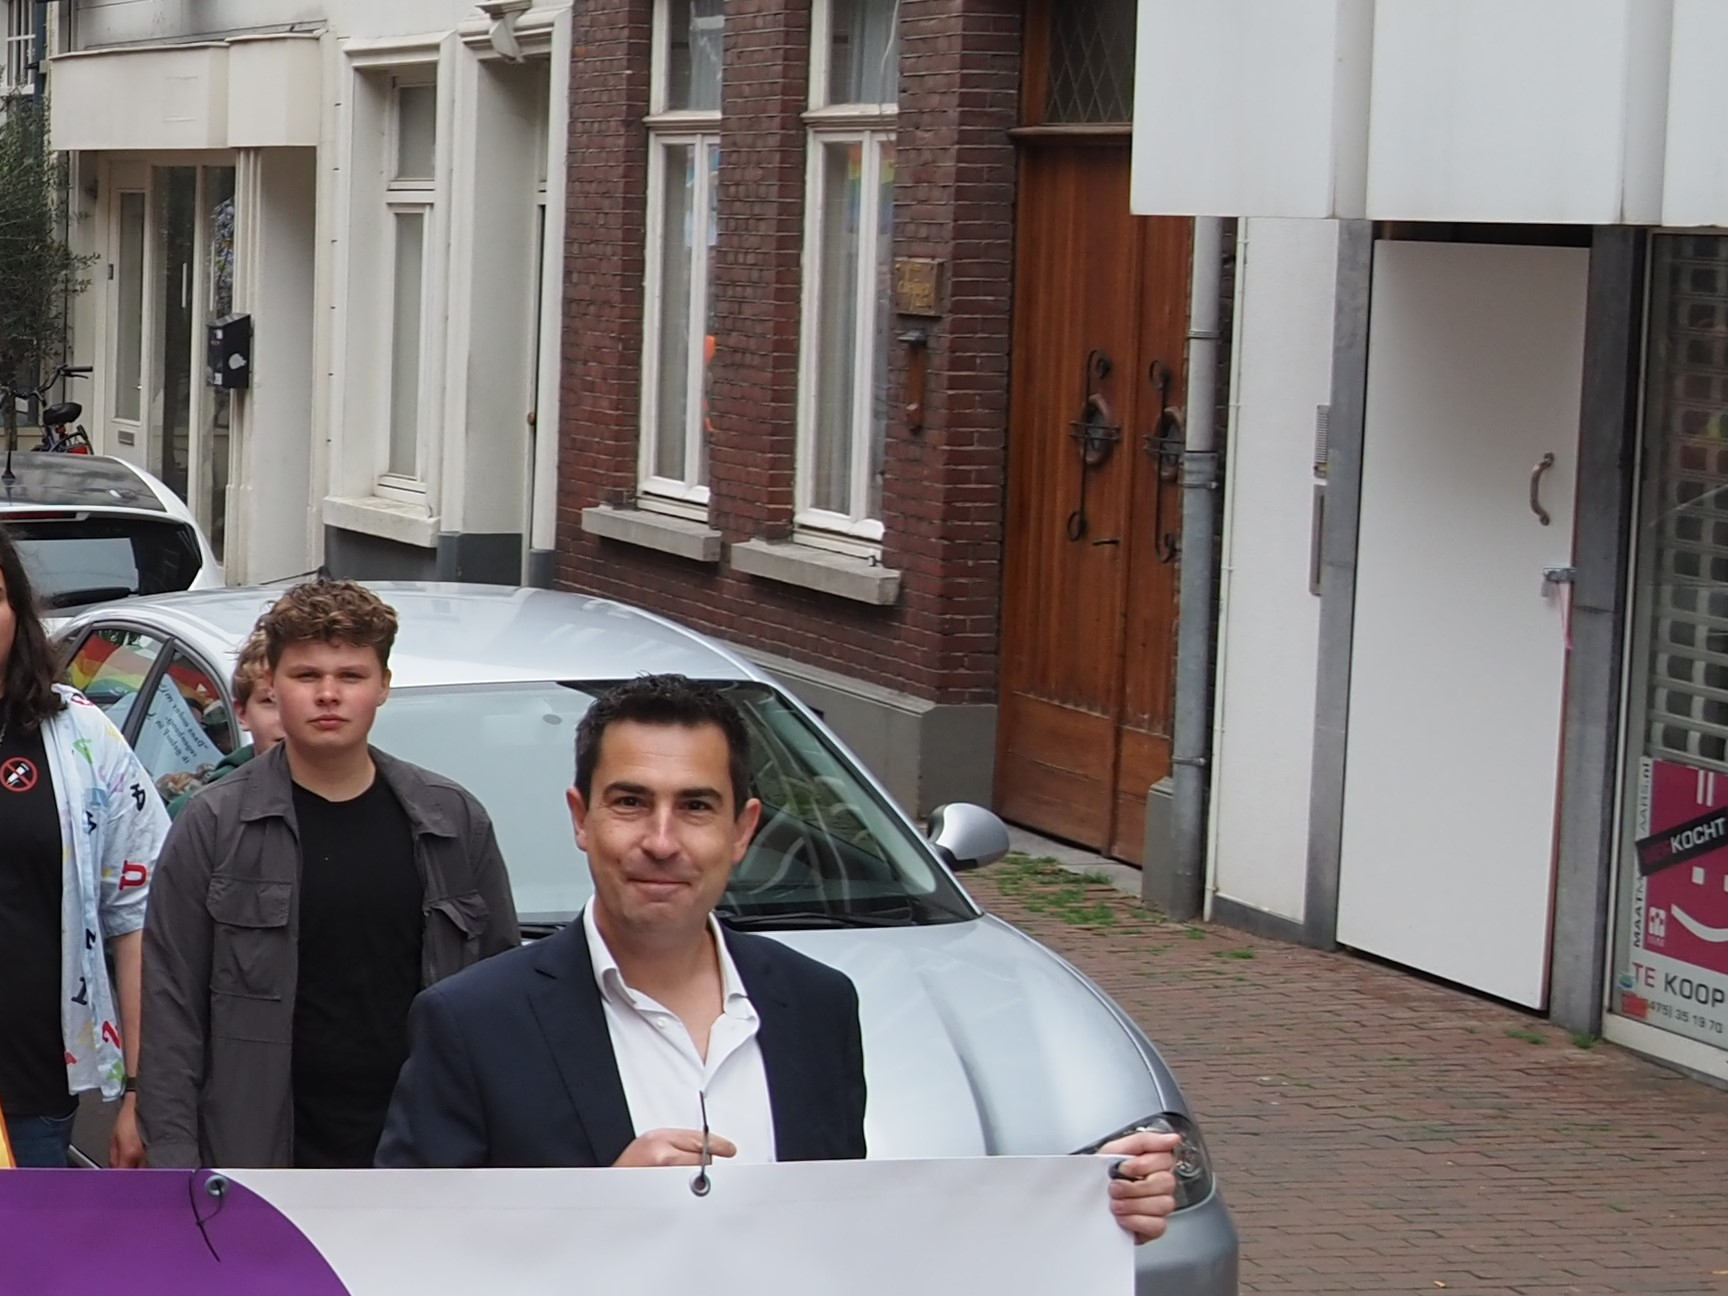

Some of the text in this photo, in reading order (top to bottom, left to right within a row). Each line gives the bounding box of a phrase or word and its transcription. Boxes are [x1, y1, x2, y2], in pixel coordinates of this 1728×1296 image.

[1632, 962, 1725, 1008] TE KOOP
[1675, 1009, 1689, 1023] 35
